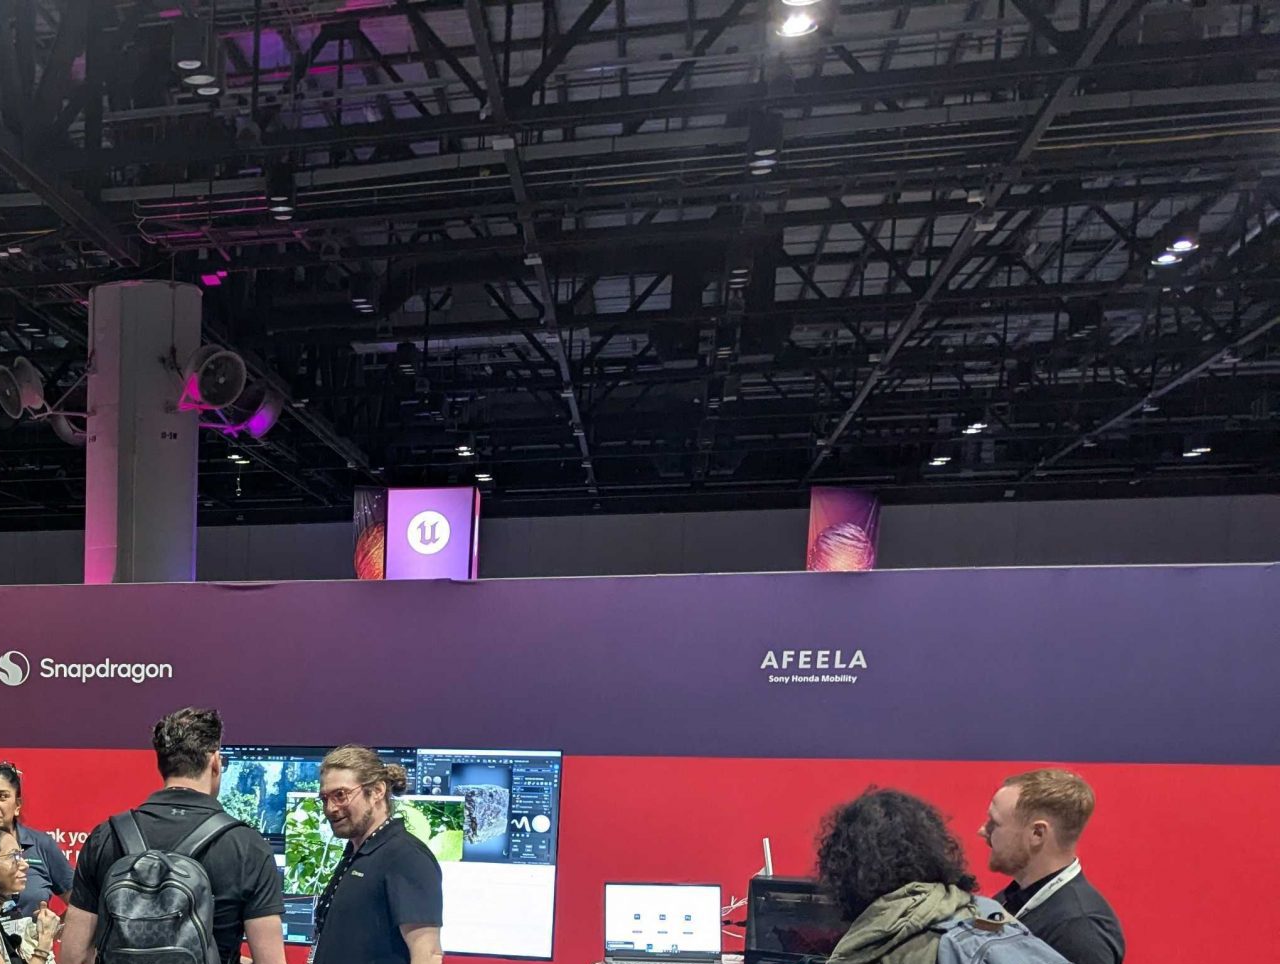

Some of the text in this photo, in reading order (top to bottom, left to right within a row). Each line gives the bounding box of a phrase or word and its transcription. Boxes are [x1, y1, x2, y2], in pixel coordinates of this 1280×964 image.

[760, 650, 868, 669] AFEELA
[40, 658, 173, 684] Snapdragon
[768, 675, 857, 684] Sony Honda Mobility
[68, 831, 90, 847] yo
